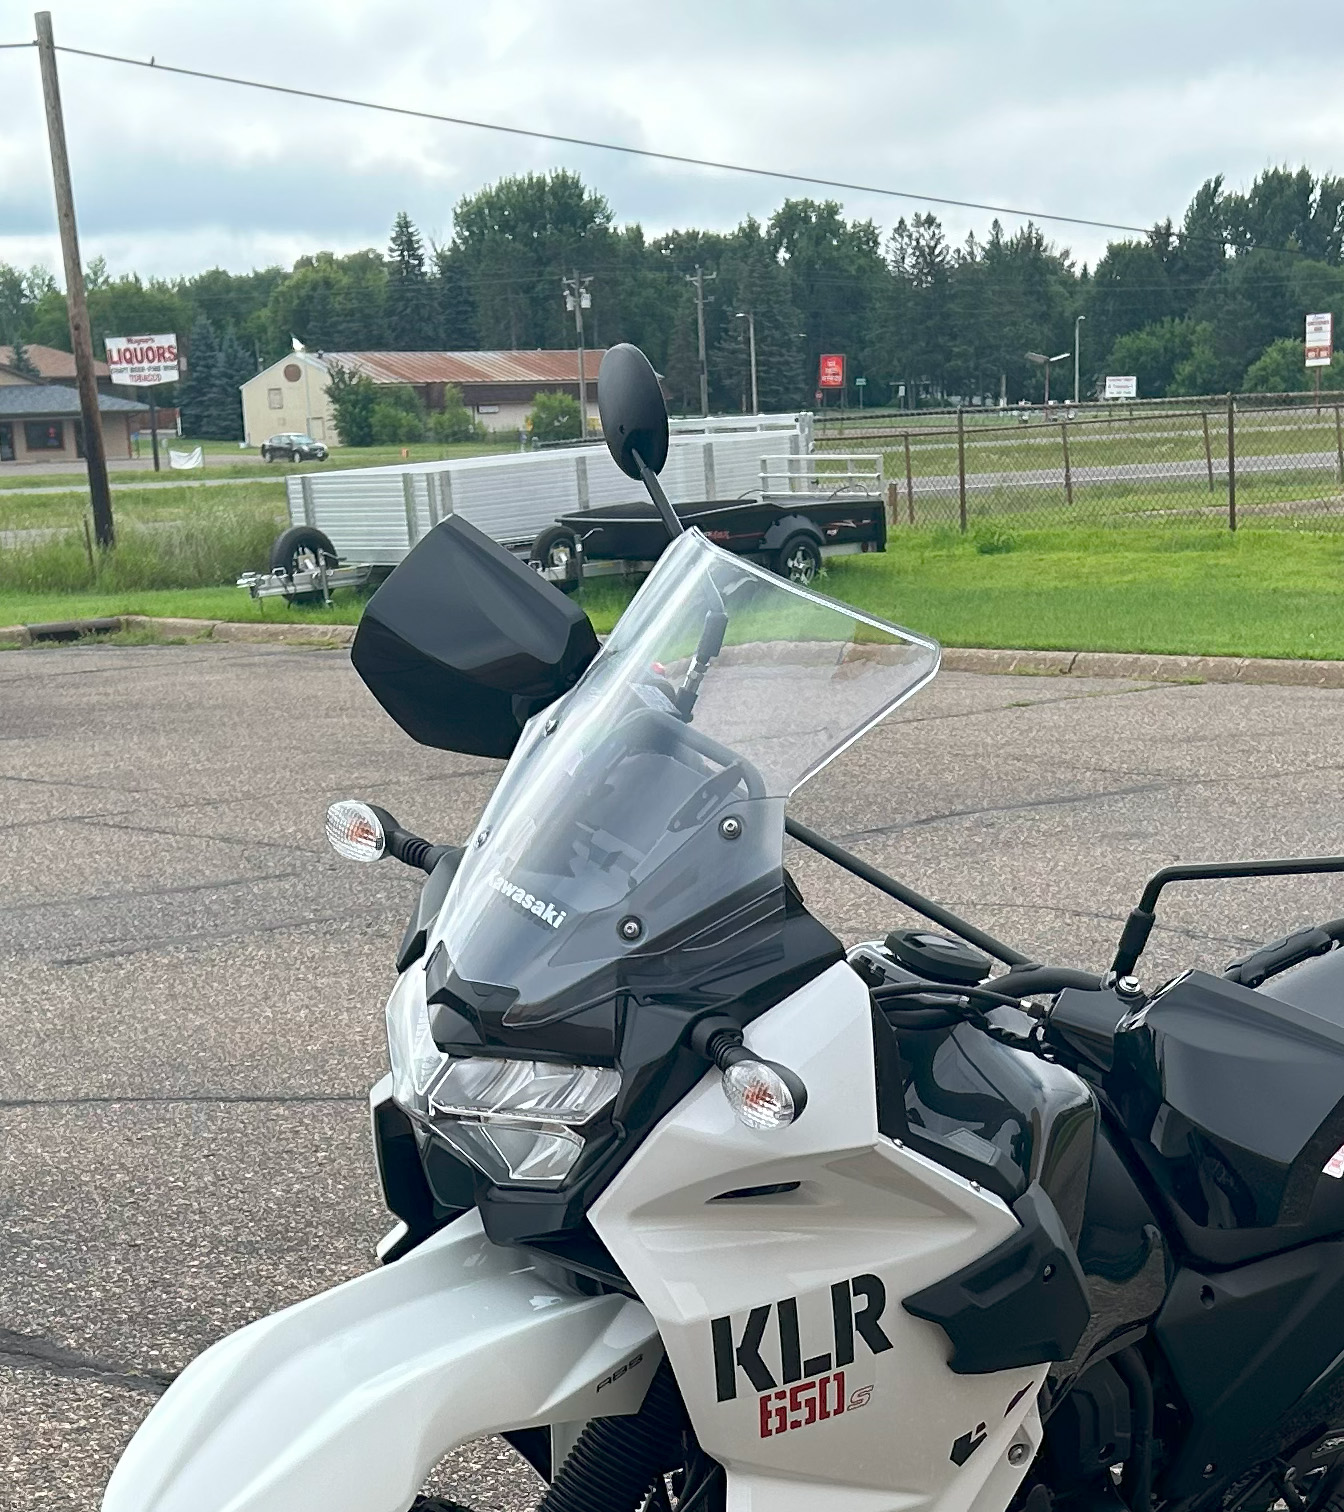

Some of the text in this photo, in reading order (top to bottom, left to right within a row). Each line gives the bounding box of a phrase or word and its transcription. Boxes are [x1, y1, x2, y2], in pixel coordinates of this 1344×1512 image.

[107, 345, 177, 366] LIQUORS
[711, 1273, 894, 1403] KLR
[596, 1353, 644, 1393] ABS
